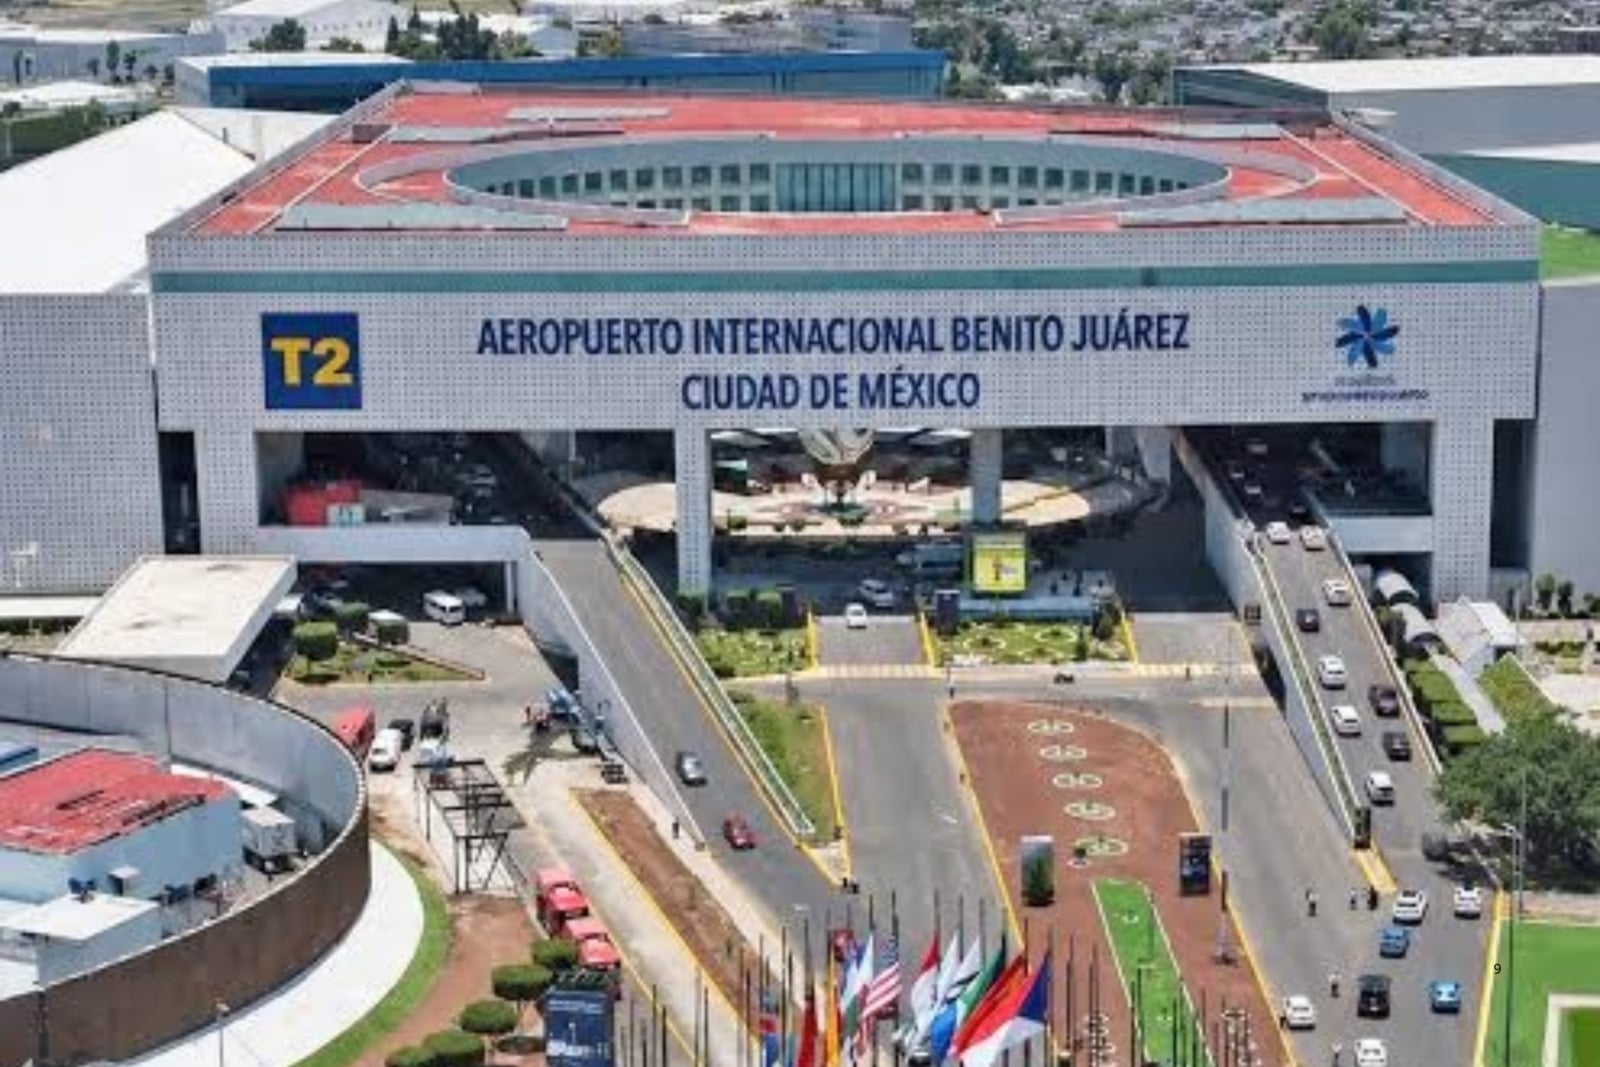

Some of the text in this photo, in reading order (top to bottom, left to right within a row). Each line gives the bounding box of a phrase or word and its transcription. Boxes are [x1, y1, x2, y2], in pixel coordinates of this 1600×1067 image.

[477, 307, 1190, 355] AEROPUERTO INTERNACIONAL BENITO JUÁREZ
[271, 338, 353, 386] T2
[681, 365, 981, 410] CIUDAD DE MÉXICO
